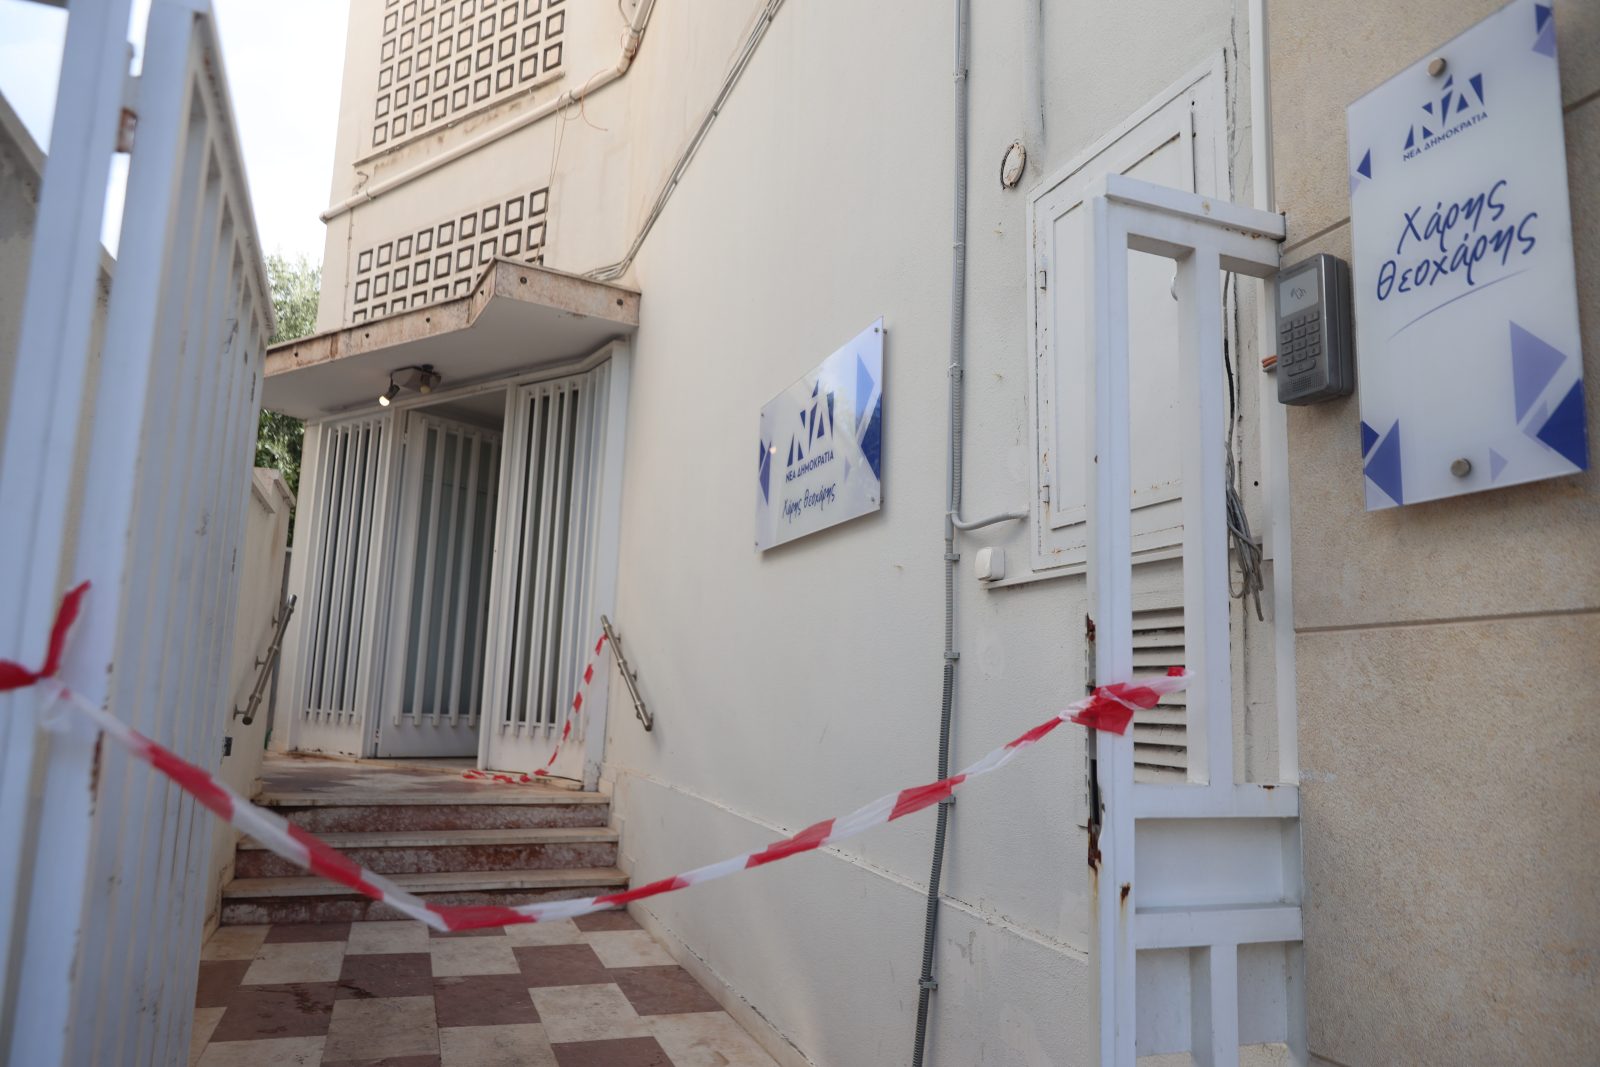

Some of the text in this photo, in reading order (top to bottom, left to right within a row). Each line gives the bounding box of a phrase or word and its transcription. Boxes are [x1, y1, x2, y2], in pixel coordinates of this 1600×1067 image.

[1424, 111, 1488, 150] ΔΗΜΟΚΡΑΤΙΑ
[1397, 180, 1507, 255] Χάρης
[797, 449, 834, 477] ΔΗΜΟΚΡΑΤΙΑ
